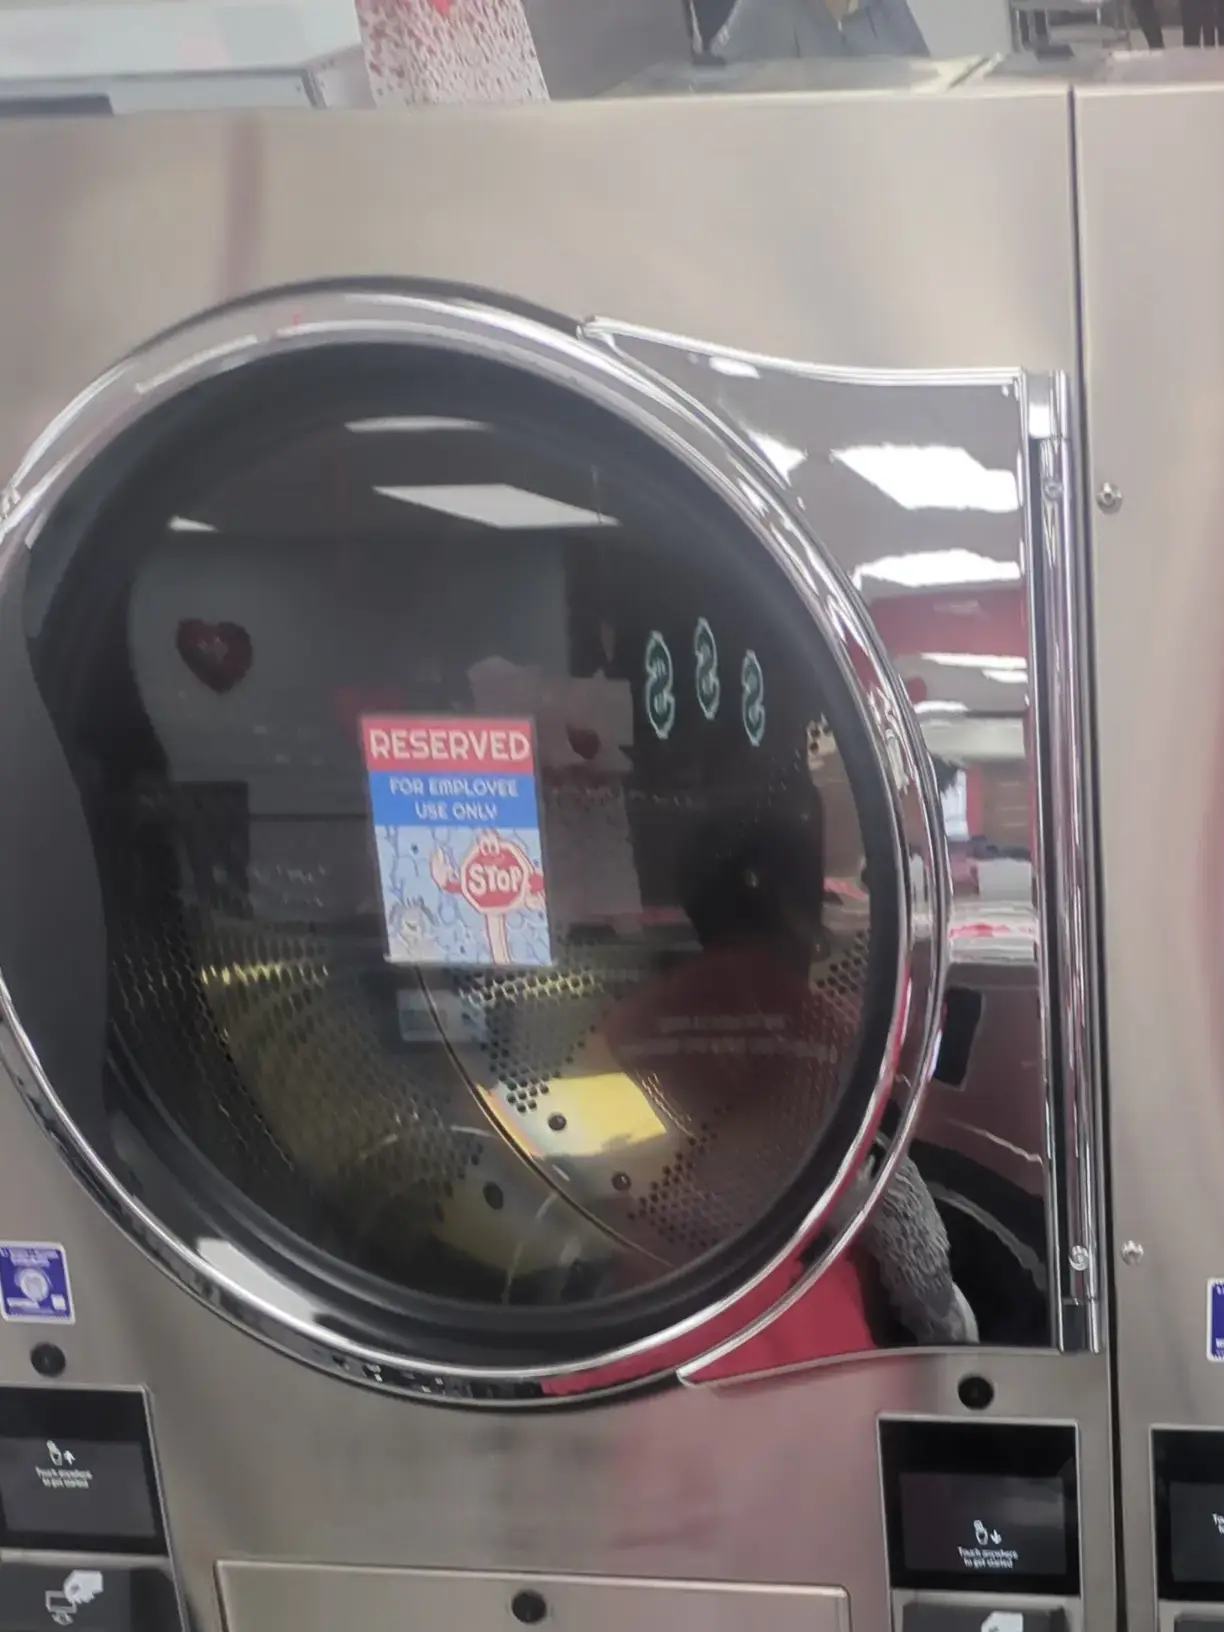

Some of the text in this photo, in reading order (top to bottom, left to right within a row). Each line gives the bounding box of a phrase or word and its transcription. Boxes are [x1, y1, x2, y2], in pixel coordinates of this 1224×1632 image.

[369, 728, 531, 761] RESERVED
[389, 777, 519, 798] FOR EMPLOYEE
[415, 801, 497, 821] USE ONLY
